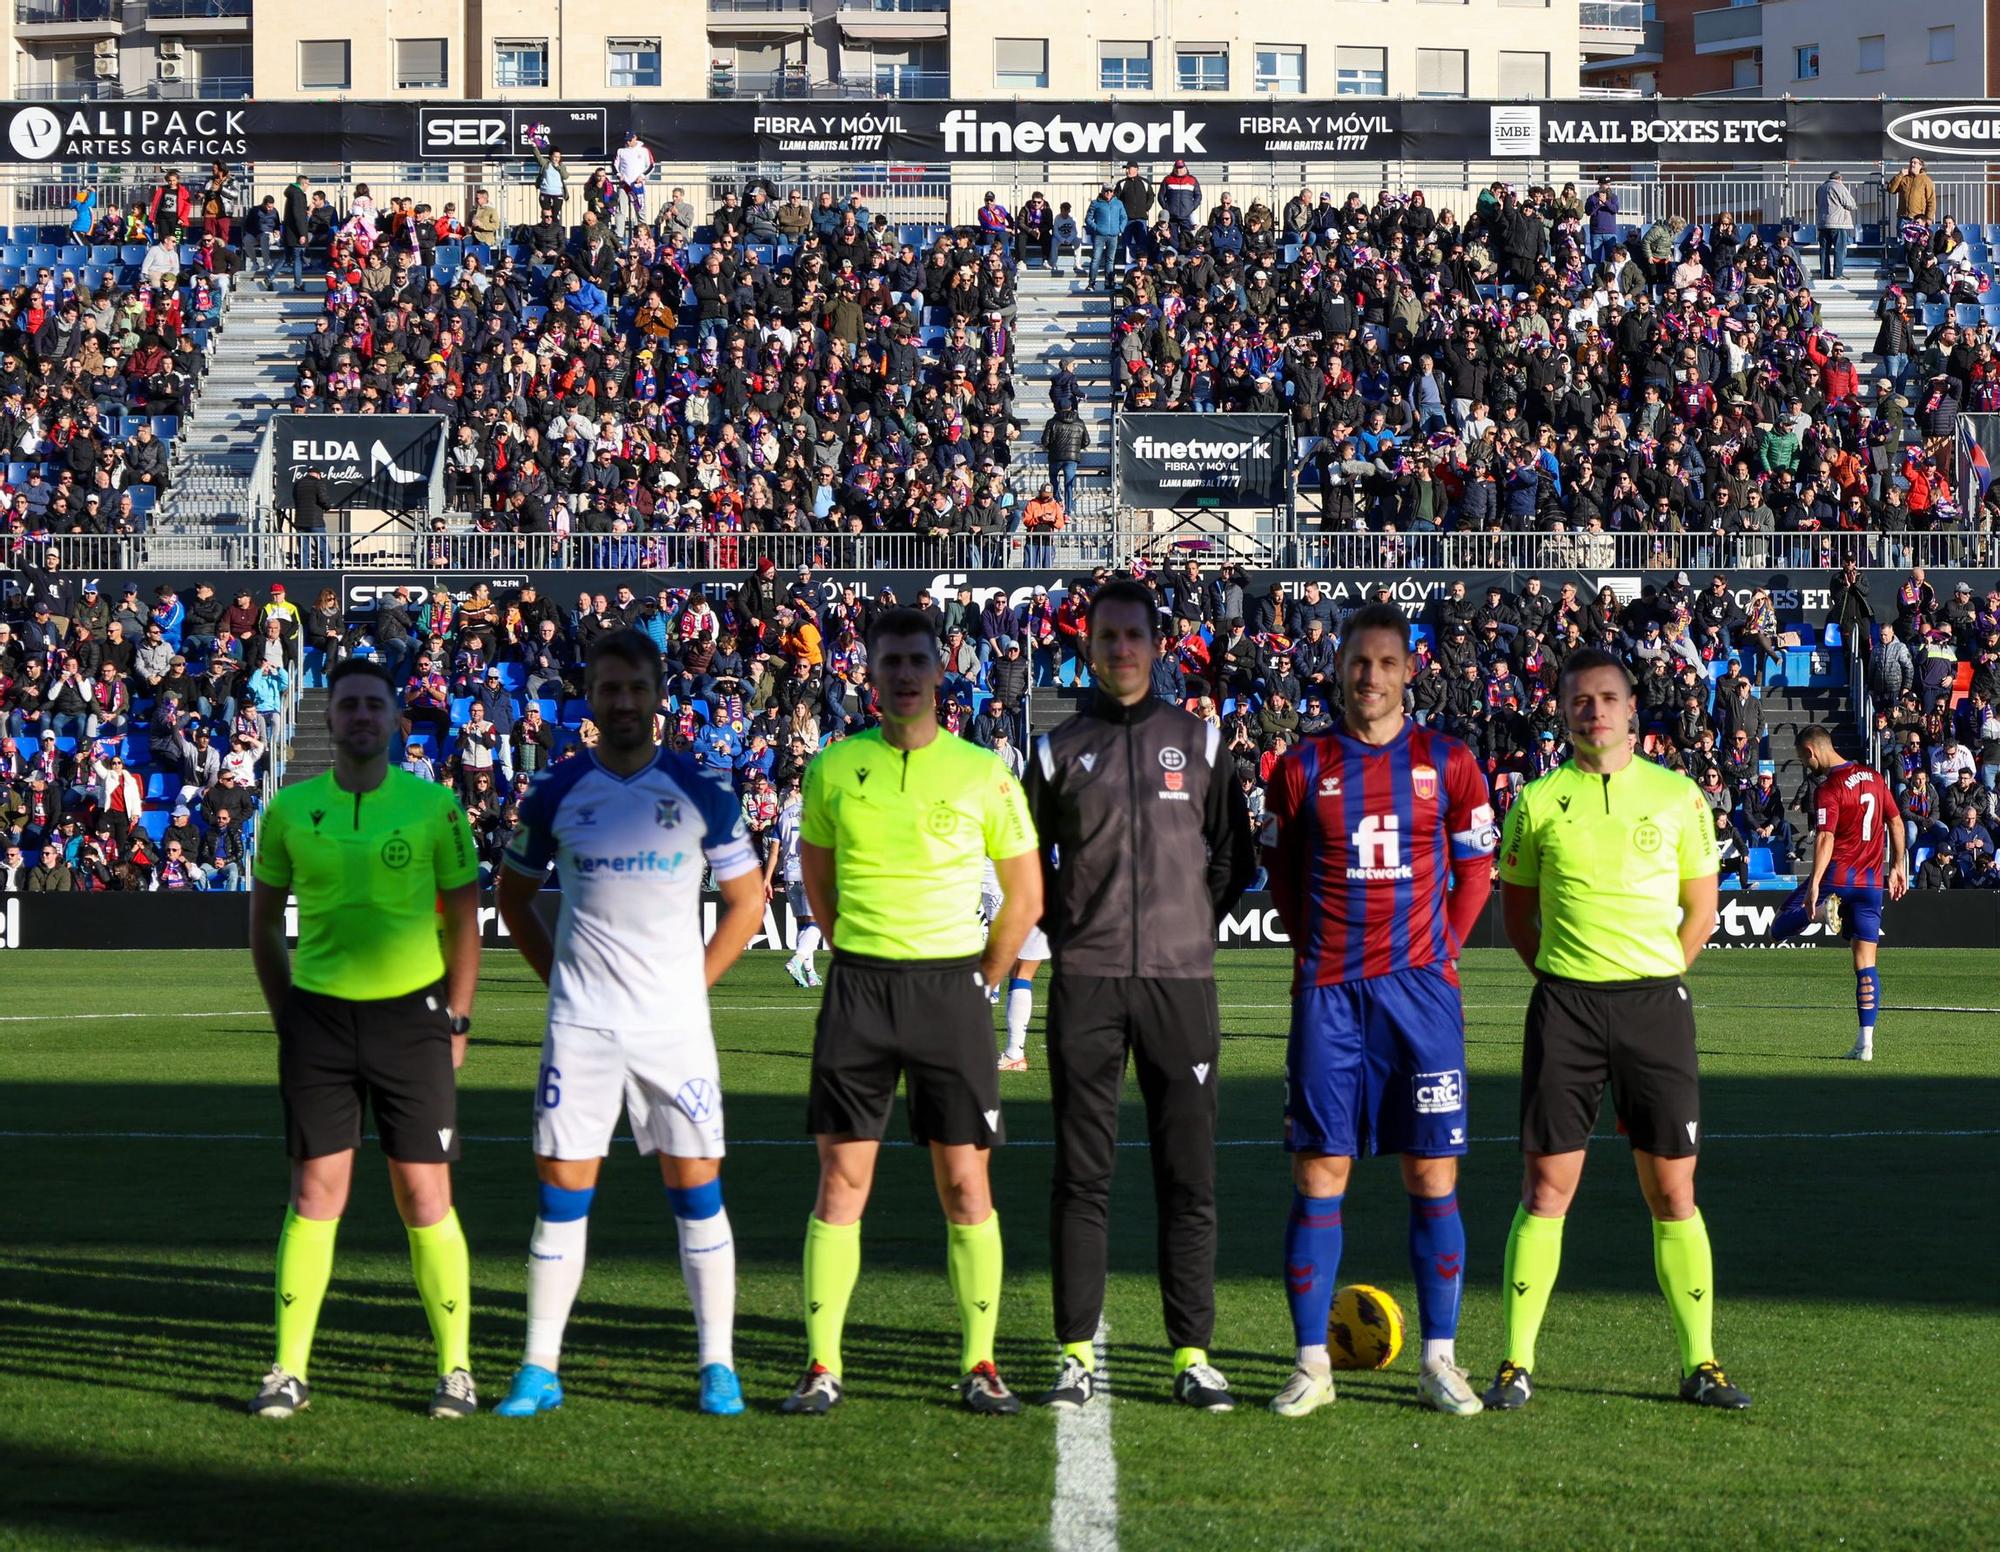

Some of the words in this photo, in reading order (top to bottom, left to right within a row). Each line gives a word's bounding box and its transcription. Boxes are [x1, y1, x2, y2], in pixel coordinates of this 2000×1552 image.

[66, 110, 246, 135] ALIPACK
[586, 113, 597, 121] FM
[754, 116, 816, 134] FIBRA
[820, 117, 836, 134] Y
[841, 112, 908, 134] MÓVIL
[1240, 116, 1302, 134] FIBRA
[1306, 117, 1322, 134] Y
[1327, 112, 1393, 134] MÓVIL
[427, 119, 506, 146] SER
[939, 109, 1207, 154] finetwork
[1500, 126, 1531, 137] MBE
[1548, 120, 1627, 143] MAIL
[1630, 119, 1719, 144] BOXES
[65, 140, 131, 155] ARTES
[141, 137, 247, 155] GRÁFICAS
[779, 140, 807, 151] LLAMA
[808, 140, 838, 151] GRATIS
[838, 140, 849, 151] AL
[850, 134, 883, 151] 1777
[1265, 140, 1293, 151] LLAMA
[1293, 140, 1324, 151] GRATIS
[1324, 140, 1335, 151] AL
[1336, 134, 1369, 151] 1777
[292, 440, 361, 461] ELDA
[1133, 435, 1271, 460] finetwork
[1165, 461, 1195, 471] FIBRA
[1197, 462, 1205, 471] Y
[1206, 459, 1239, 471] MÓVIL
[1159, 479, 1182, 488] LLAMA
[1182, 479, 1206, 488] GRATIS
[1206, 479, 1215, 488] AL
[1216, 475, 1241, 488] 1777
[507, 580, 519, 588] FM
[1354, 581, 1374, 600] Y
[1860, 792, 1875, 841] 7
[1346, 865, 1414, 880] network
[1416, 1083, 1459, 1103] CRC
